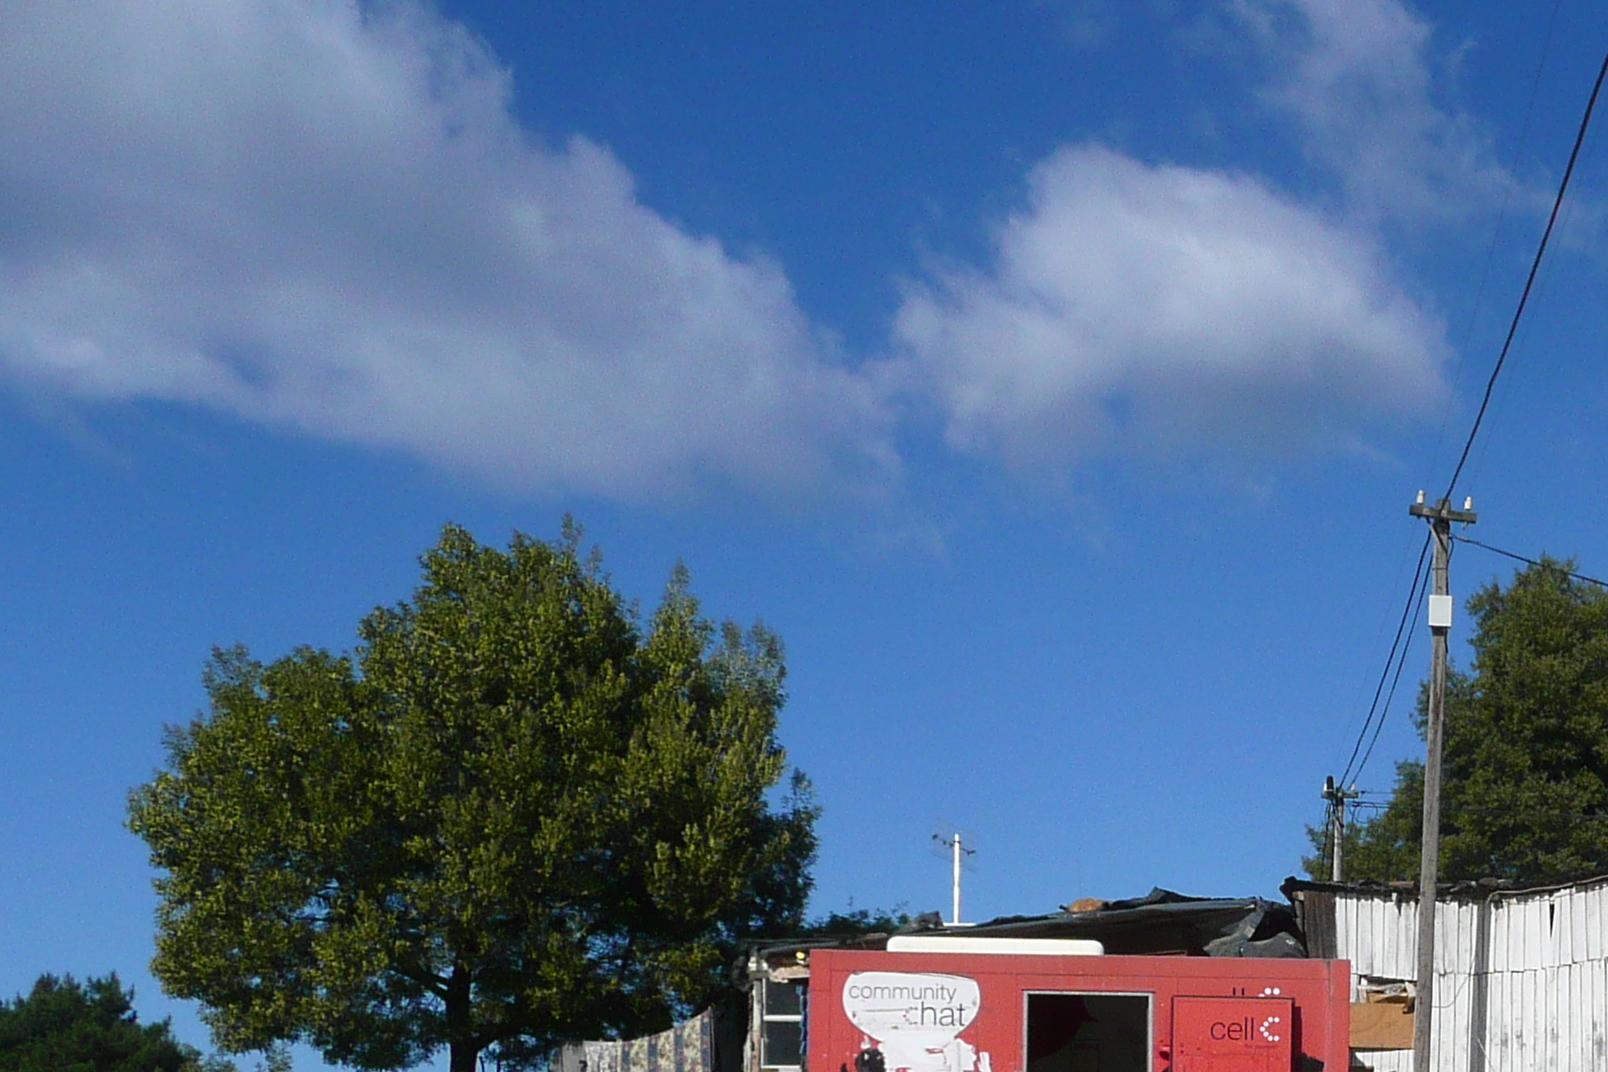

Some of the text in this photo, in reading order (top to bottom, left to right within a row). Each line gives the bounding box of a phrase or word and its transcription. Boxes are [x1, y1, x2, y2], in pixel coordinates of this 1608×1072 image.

[849, 983, 957, 1004] community
[902, 1001, 966, 1027] chat
[1210, 1016, 1254, 1041] cell
